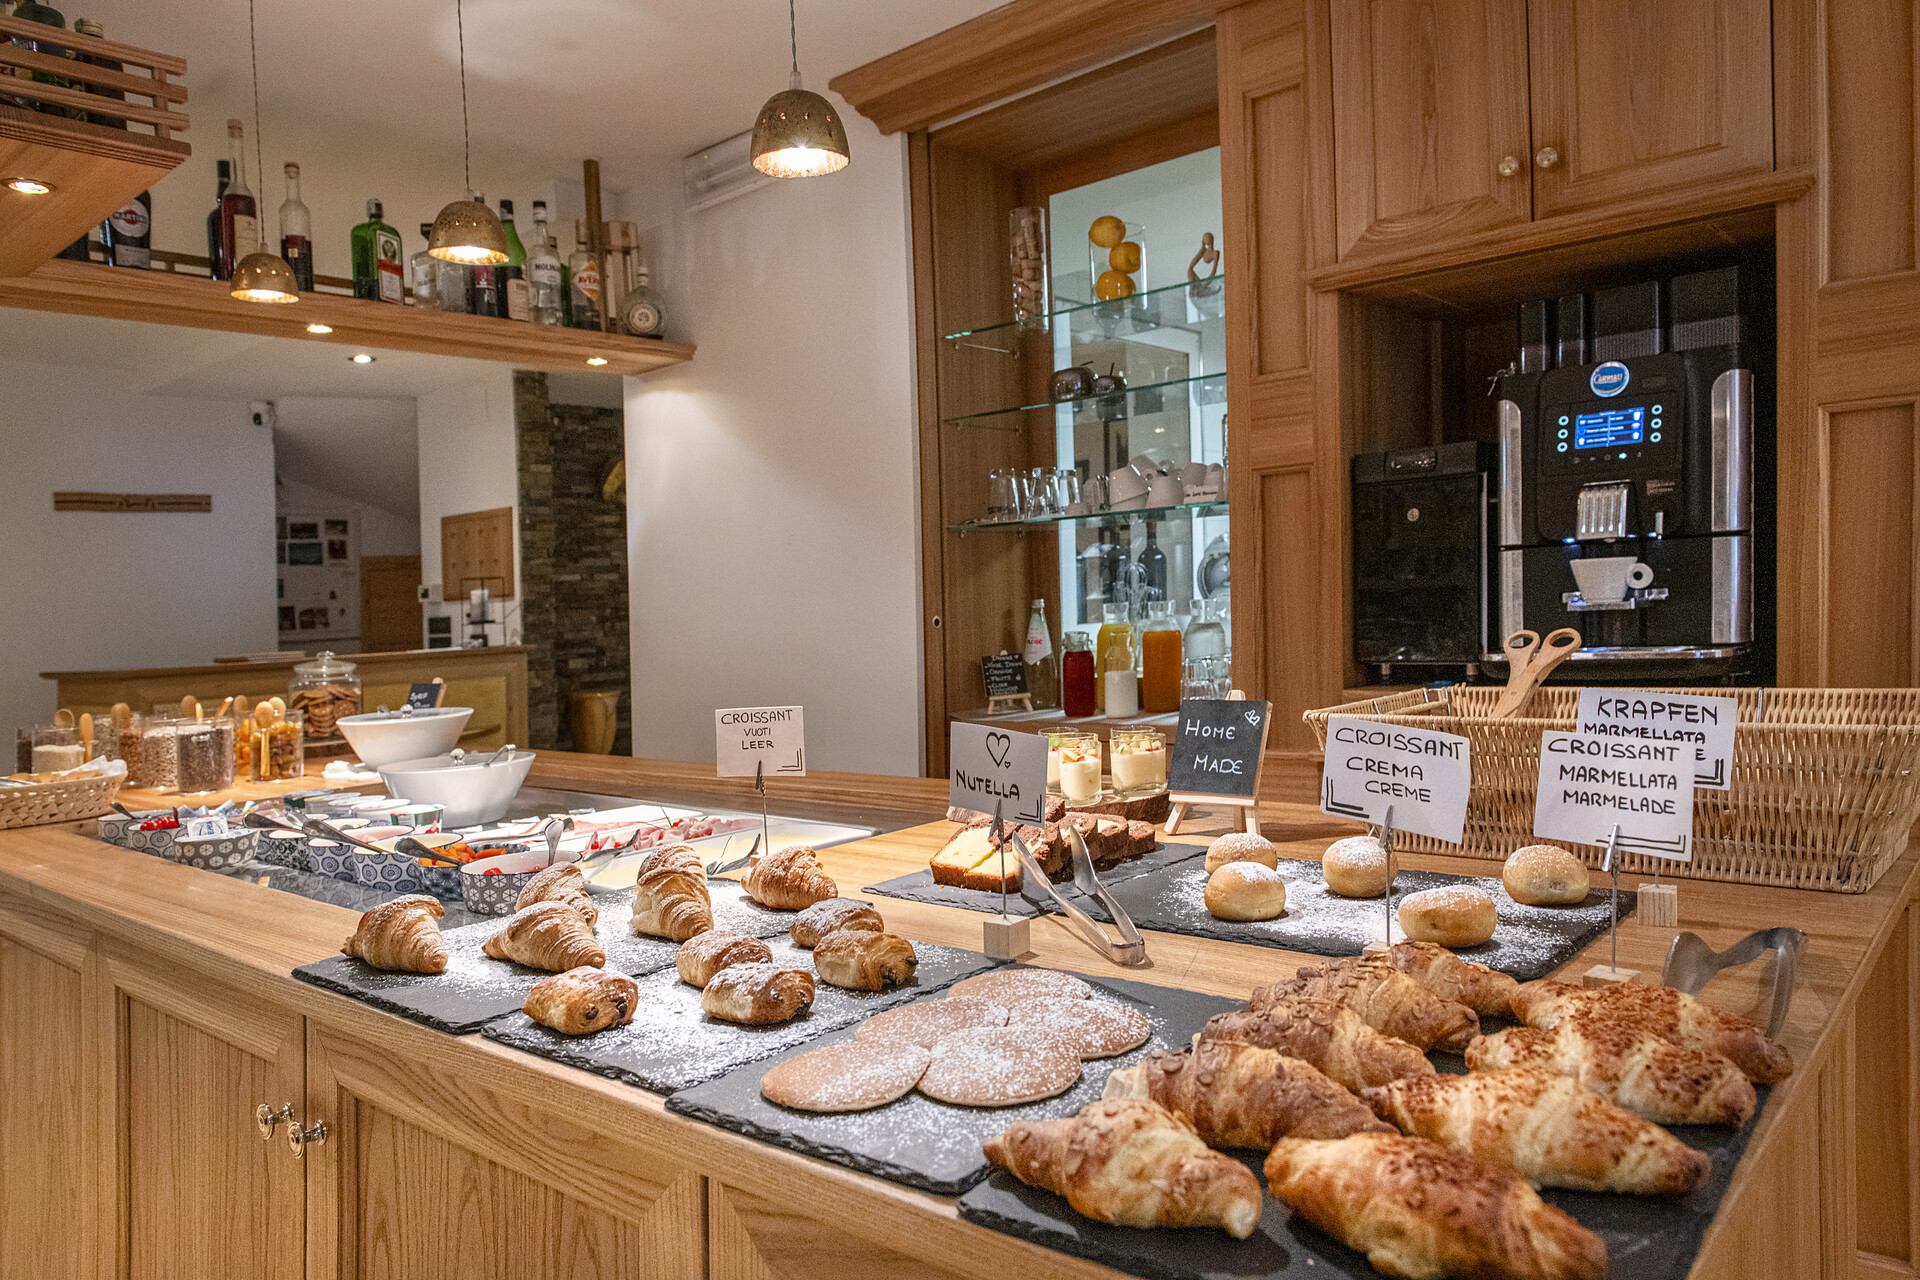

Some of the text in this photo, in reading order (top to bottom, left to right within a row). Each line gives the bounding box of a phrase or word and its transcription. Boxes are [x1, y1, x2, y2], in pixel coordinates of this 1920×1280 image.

[721, 709, 793, 725] CROISSANT
[1597, 696, 1718, 726] KRAPFEN
[743, 727, 771, 737] VUOTI
[1335, 727, 1464, 760] CROISSANT
[1584, 722, 1706, 745] MARMELLATA
[741, 739, 775, 750] LEER
[1548, 738, 1680, 762] CROISSANT
[1193, 754, 1243, 775] MADE
[1346, 756, 1423, 781] CREMA
[956, 769, 1020, 801] NUTELLA
[1559, 764, 1677, 790] MARMELLATA
[1365, 780, 1431, 803] CREME
[1563, 790, 1676, 815] MARMELADE
